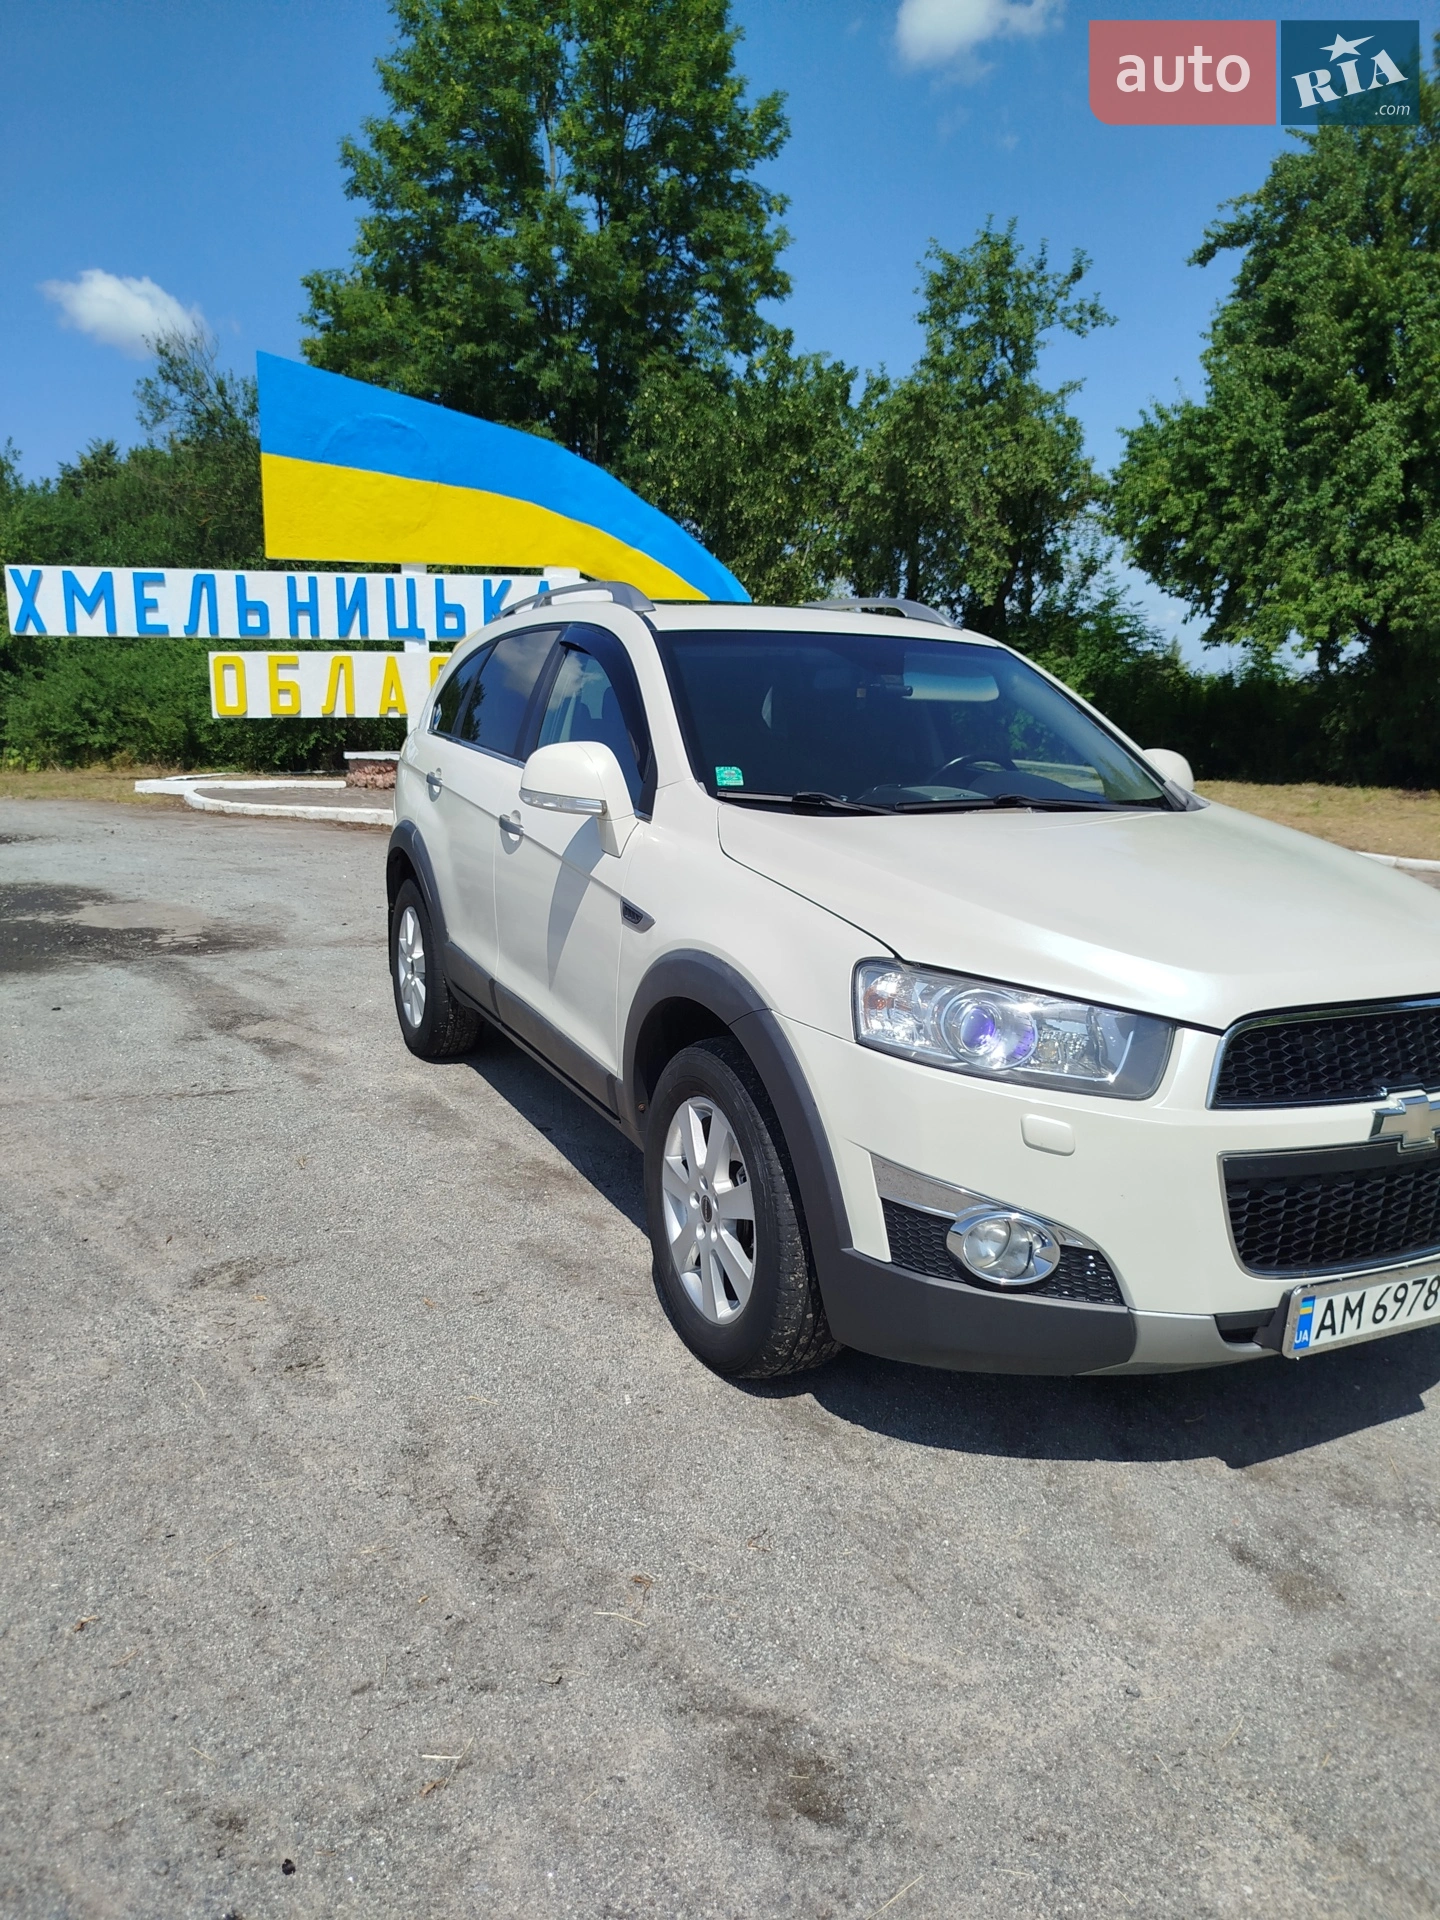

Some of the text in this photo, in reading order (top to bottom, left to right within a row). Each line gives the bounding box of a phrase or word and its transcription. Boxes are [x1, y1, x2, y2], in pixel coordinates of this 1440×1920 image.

[1314, 1275, 1440, 1340] AM 6978
[1294, 1329, 1309, 1344] UA
